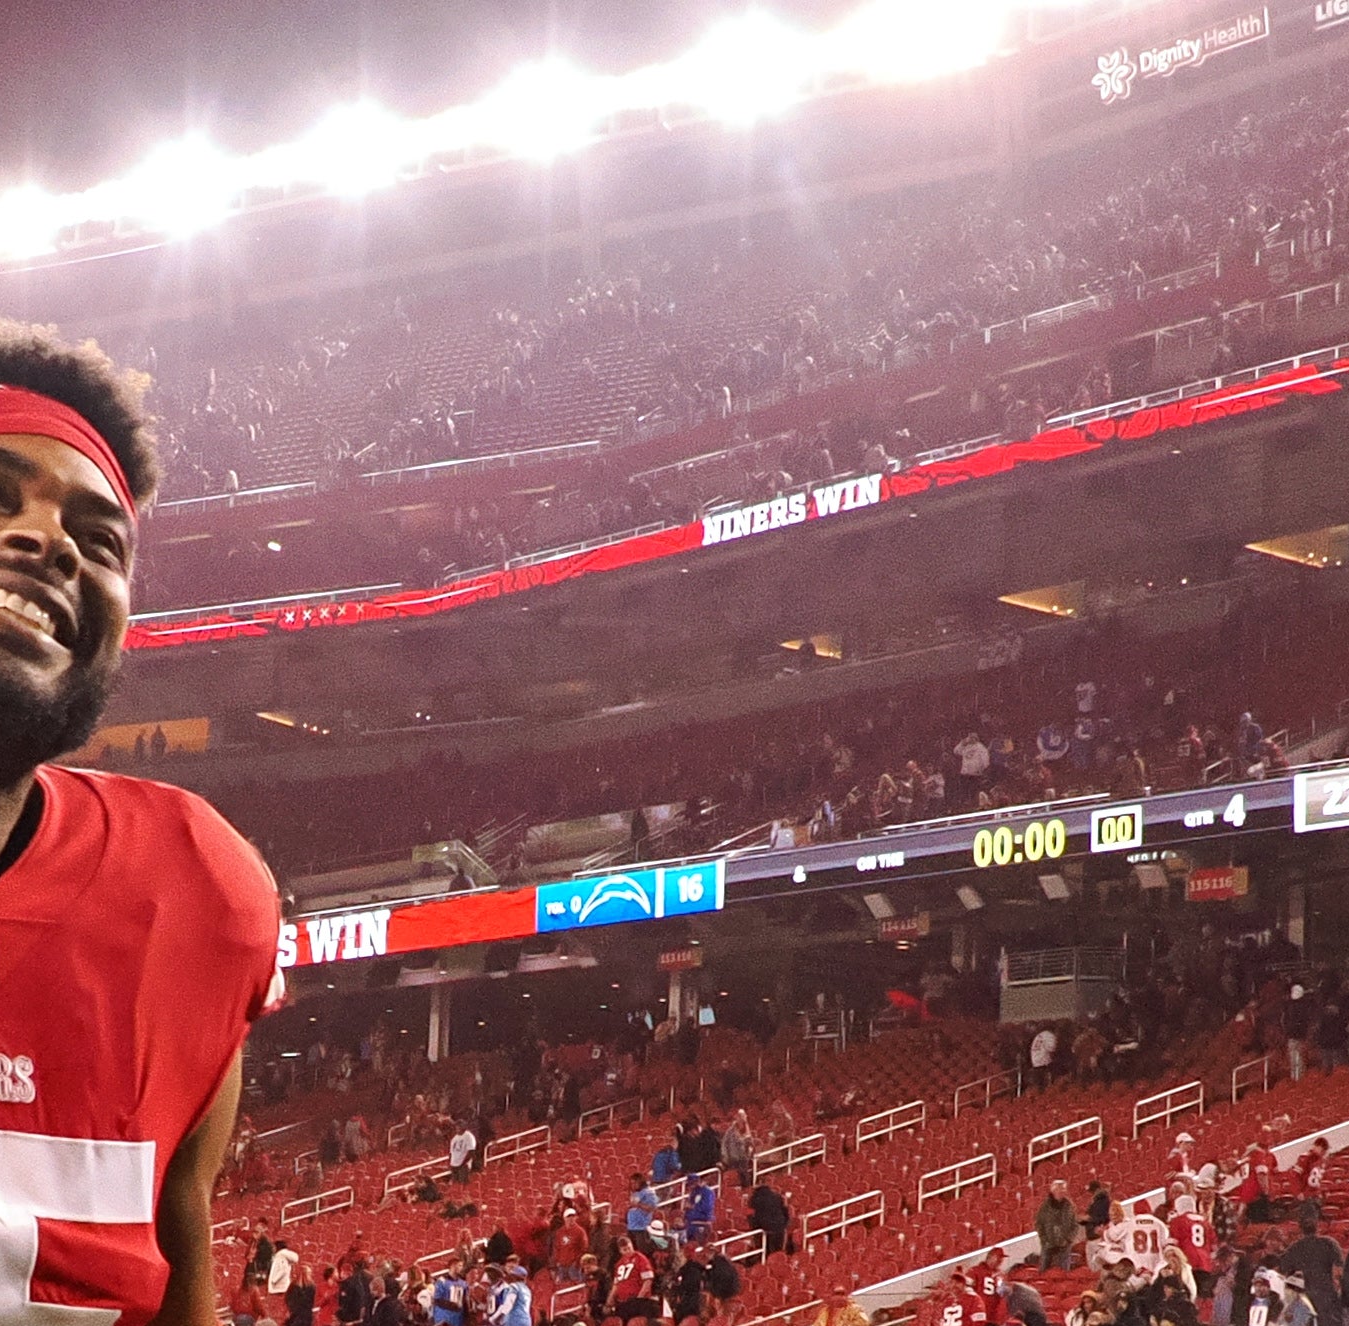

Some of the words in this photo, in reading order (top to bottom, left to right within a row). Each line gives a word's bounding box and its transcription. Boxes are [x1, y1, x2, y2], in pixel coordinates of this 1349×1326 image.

[1139, 39, 1201, 73] Dignity
[1204, 14, 1261, 49] Health
[702, 493, 806, 546] NINERS
[813, 473, 882, 517] WIN
[1183, 809, 1215, 829] QTR
[1223, 793, 1247, 827] 4
[973, 818, 1067, 868] 00:00
[1101, 816, 1133, 845] 00
[677, 874, 704, 904] 16
[570, 896, 582, 914] 0
[306, 909, 391, 963] WIN
[1132, 1228, 1160, 1255] 81
[1191, 1224, 1205, 1247] 8
[617, 1263, 635, 1281] 97
